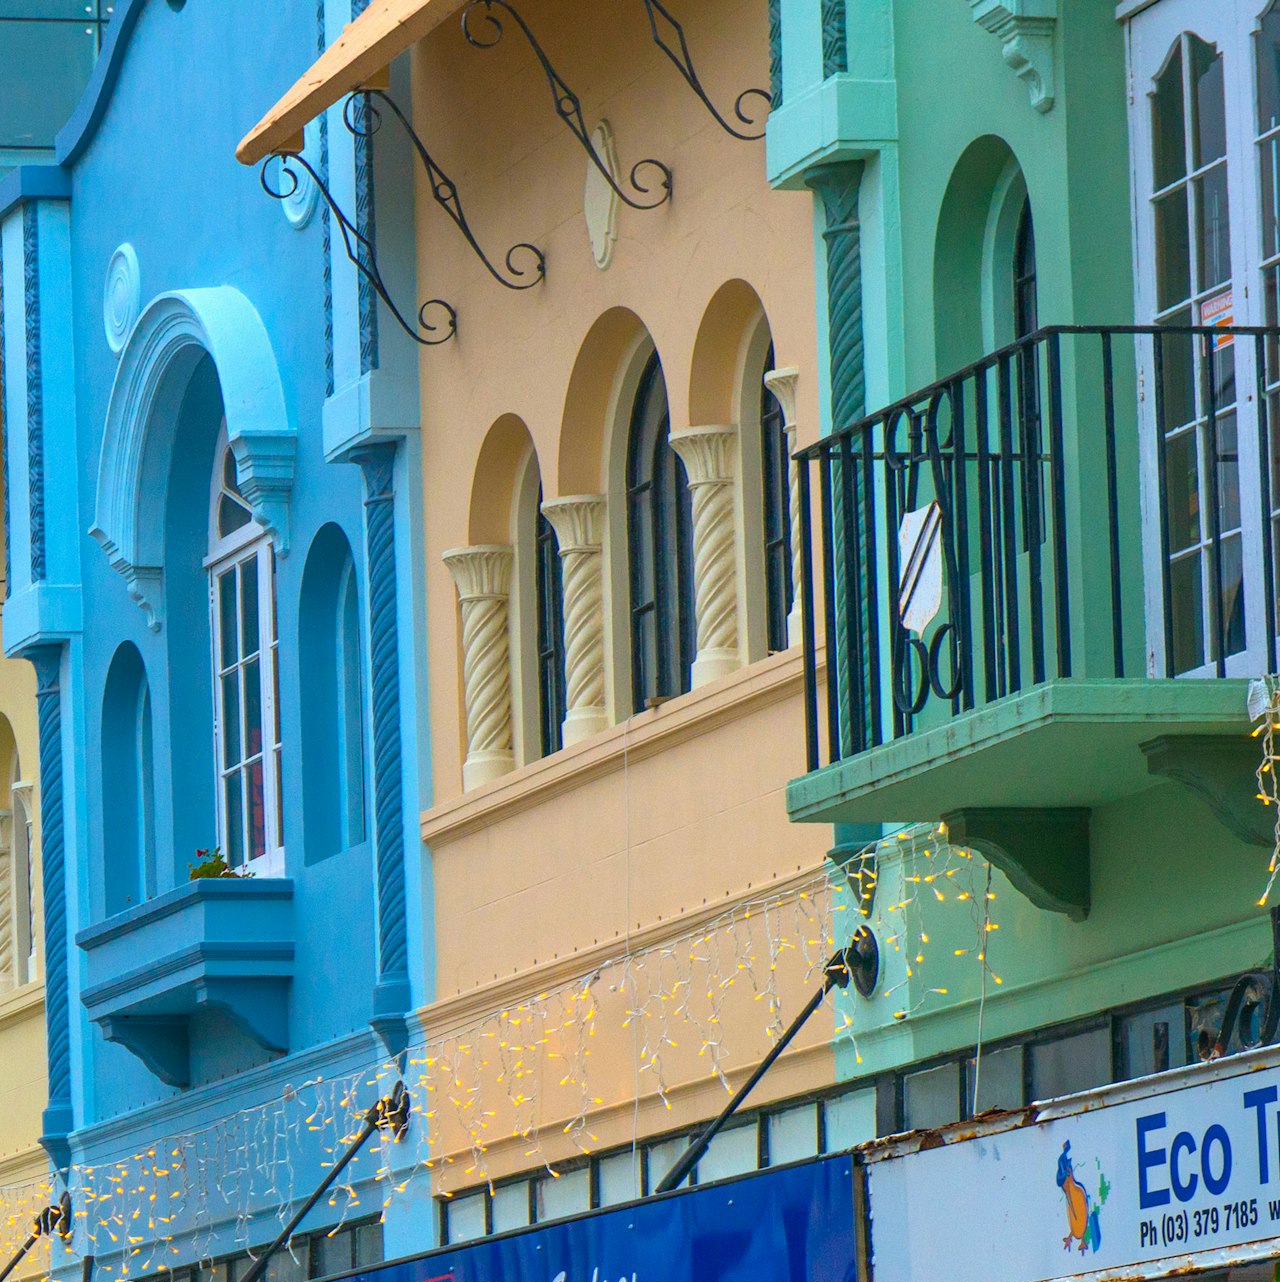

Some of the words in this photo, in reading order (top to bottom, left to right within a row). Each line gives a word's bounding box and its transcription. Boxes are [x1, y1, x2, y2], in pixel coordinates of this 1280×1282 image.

[1136, 1111, 1233, 1210] Eco
[1243, 1085, 1280, 1185] T
[1140, 1219, 1158, 1248] Ph
[1161, 1209, 1189, 1247] (03)
[1193, 1207, 1219, 1237] 379
[1224, 1199, 1258, 1231] 7185
